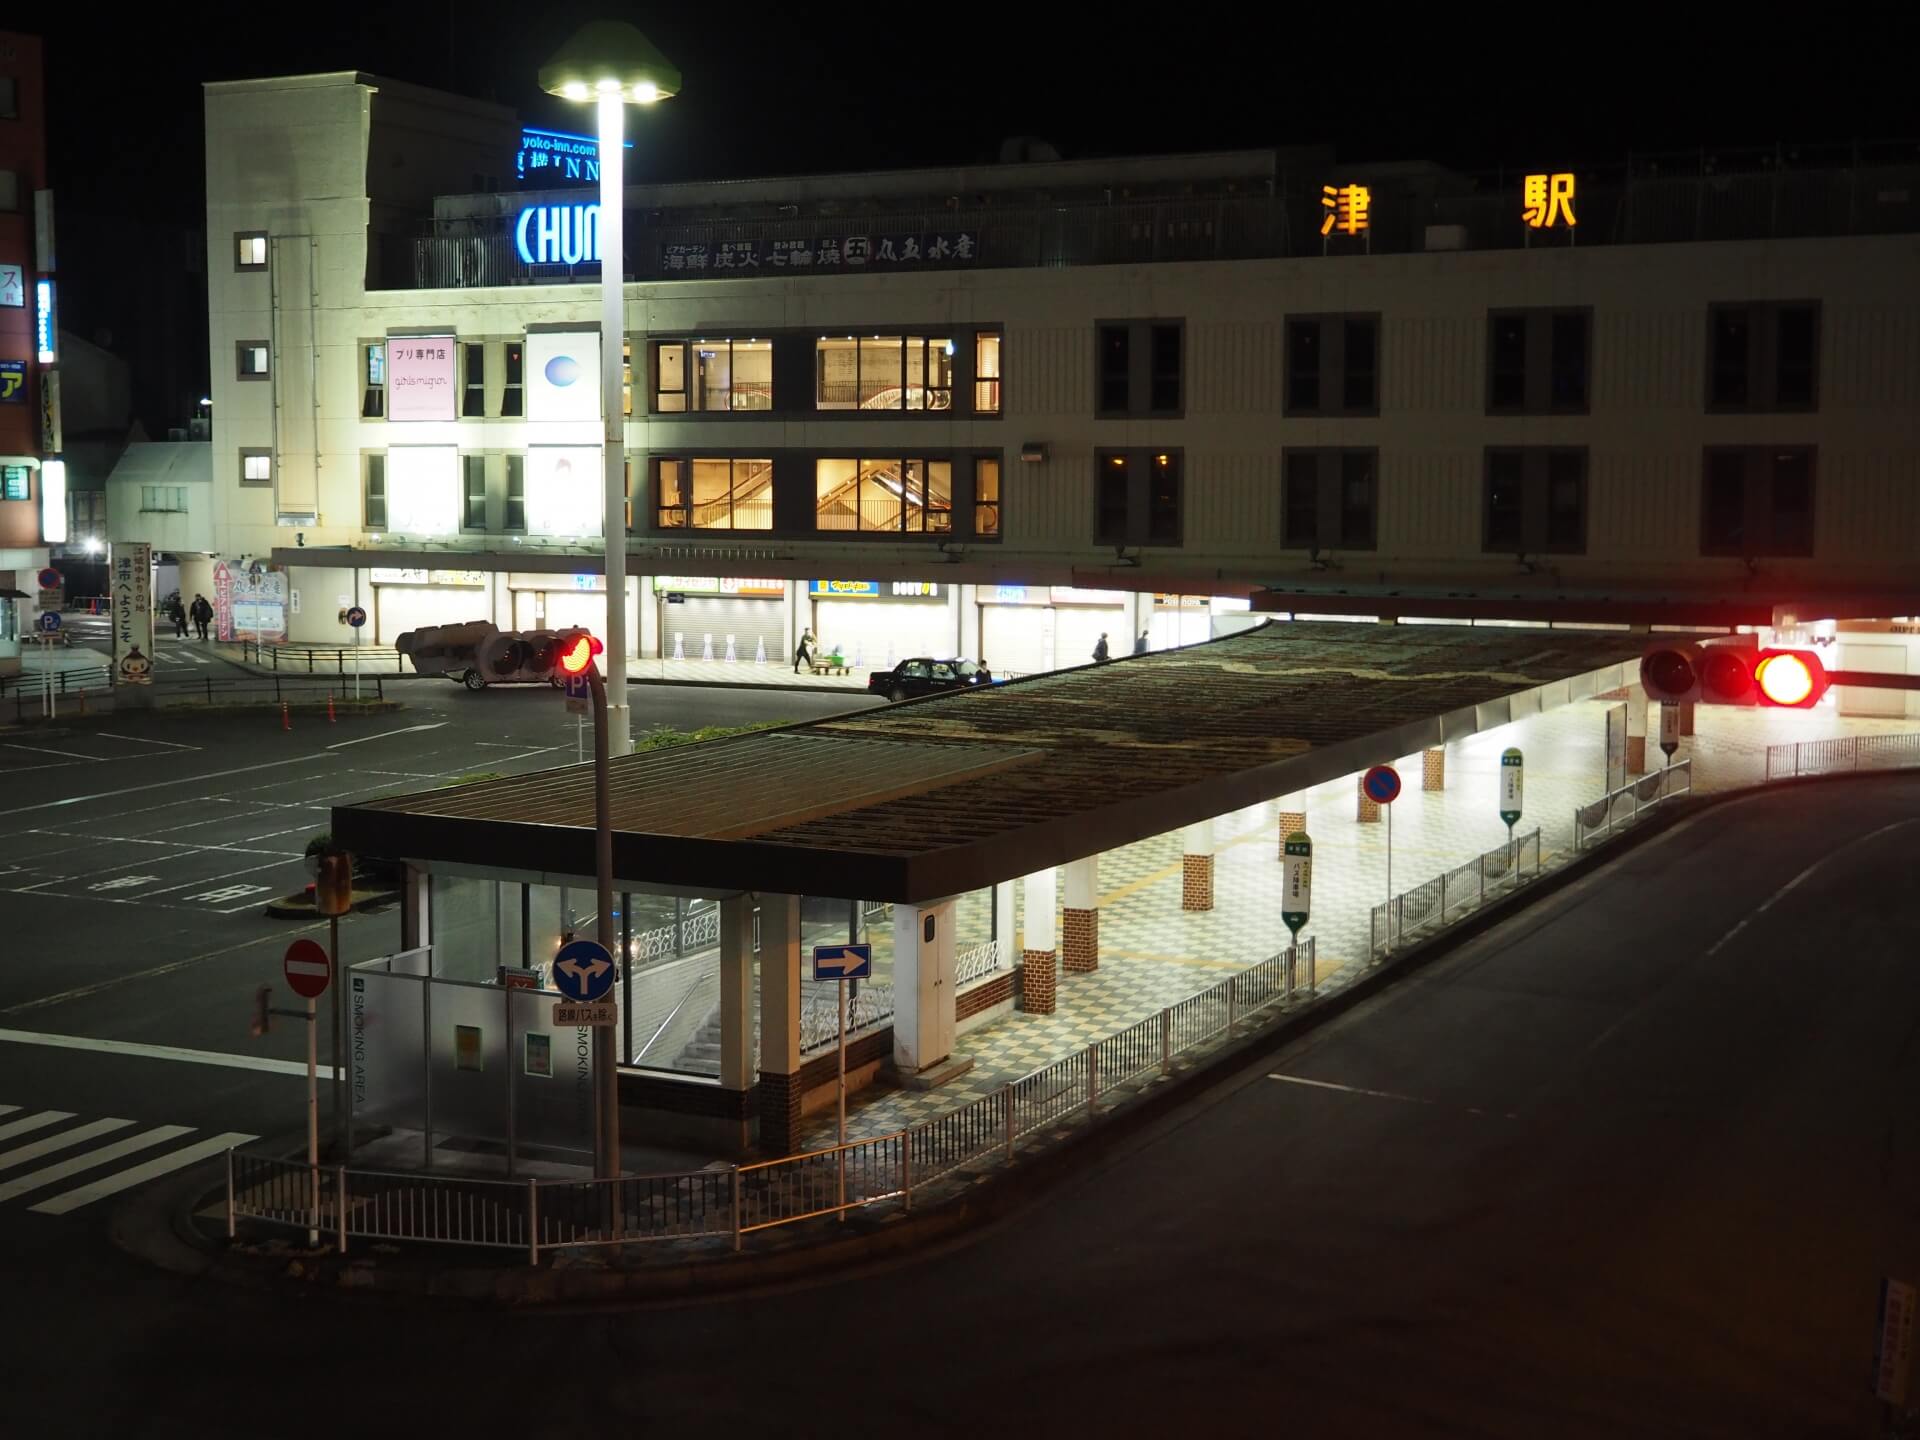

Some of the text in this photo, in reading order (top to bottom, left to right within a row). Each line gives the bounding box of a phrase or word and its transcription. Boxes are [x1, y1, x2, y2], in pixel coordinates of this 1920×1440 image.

[1320, 173, 1577, 235] 津 駅
[119, 557, 131, 643] 津市へようこそ
[353, 994, 366, 1062] SMOKING
